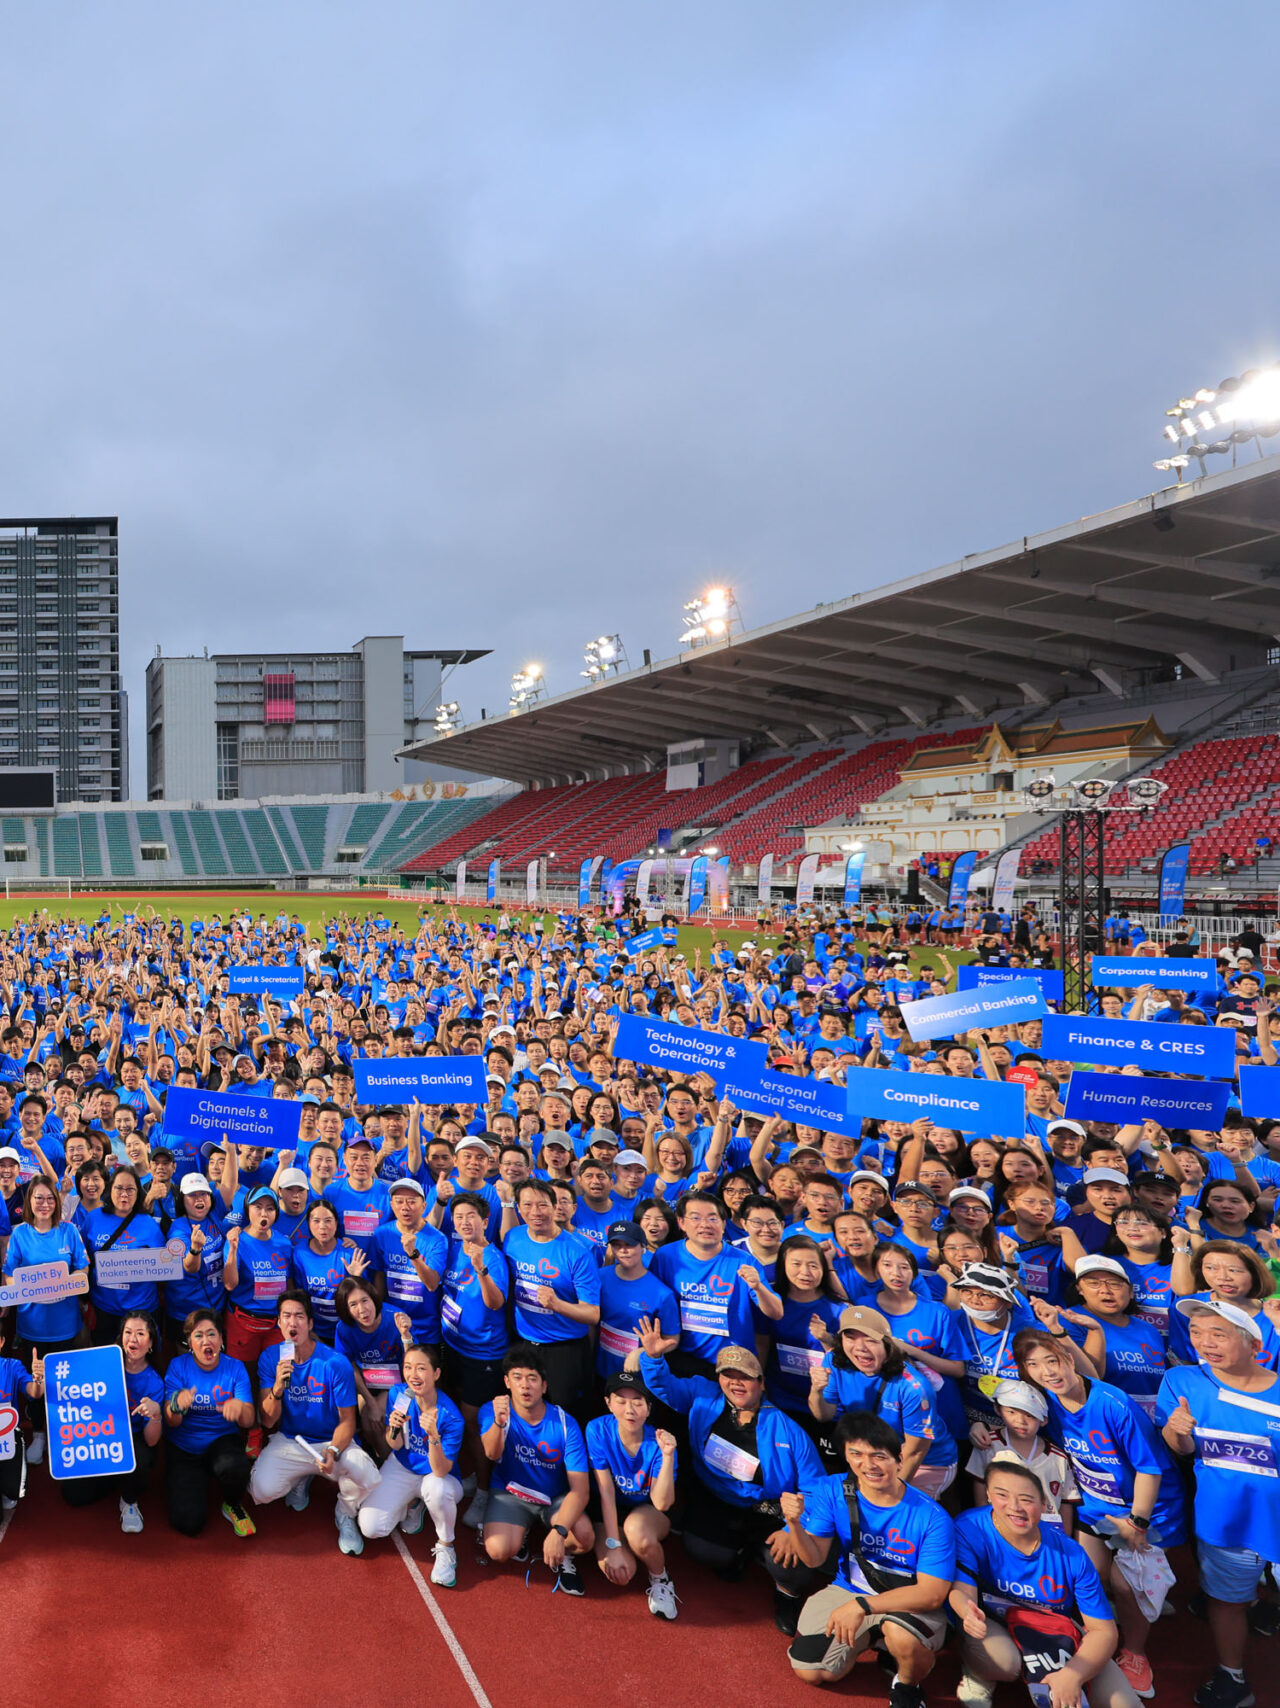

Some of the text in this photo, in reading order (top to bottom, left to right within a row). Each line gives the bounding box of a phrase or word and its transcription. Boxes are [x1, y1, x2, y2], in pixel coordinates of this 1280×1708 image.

[233, 976, 252, 984] Legal
[260, 975, 299, 984] Secretariat
[977, 972, 1013, 982] Special
[1098, 966, 1208, 979] Corporate Banking
[909, 994, 1038, 1026] Commercial Banking
[645, 1028, 737, 1058] Technology &
[1068, 1032, 1205, 1055] Finance & CRES
[648, 1043, 726, 1070] Operations
[366, 1073, 473, 1087] Business Banking
[760, 1078, 817, 1101] ersonal
[724, 1083, 844, 1122] Financial Services
[883, 1088, 980, 1111] Compliance
[1081, 1090, 1213, 1112] Human Resources
[198, 1100, 268, 1119] Channels &
[189, 1114, 274, 1135] Digitalisation
[96, 1233, 110, 1242] UO
[99, 1256, 156, 1268] Volunteering
[252, 1261, 271, 1271] UOB
[388, 1253, 408, 1264] UOB
[516, 1261, 536, 1274] UOB
[21, 1269, 62, 1284] Right By
[100, 1269, 127, 1278] makes
[144, 1267, 174, 1276] happy
[253, 1268, 287, 1277] Heartbeat
[306, 1276, 326, 1286] UOB
[516, 1270, 553, 1287] Heartbeat
[0, 1279, 86, 1301] Our Communities
[680, 1282, 707, 1294] UOB
[680, 1291, 729, 1305] Heartbeat
[1113, 1350, 1144, 1364] UOB
[55, 1360, 70, 1379] #
[56, 1380, 107, 1402] keep
[288, 1394, 324, 1404] Heartbeat
[58, 1402, 92, 1423] the
[59, 1415, 115, 1445] good
[61, 1438, 124, 1468] going
[514, 1452, 556, 1470] Heartbeat
[1203, 1441, 1269, 1463] M 3726
[1079, 1472, 1112, 1494] 3724
[996, 1578, 1036, 1599] UOB
